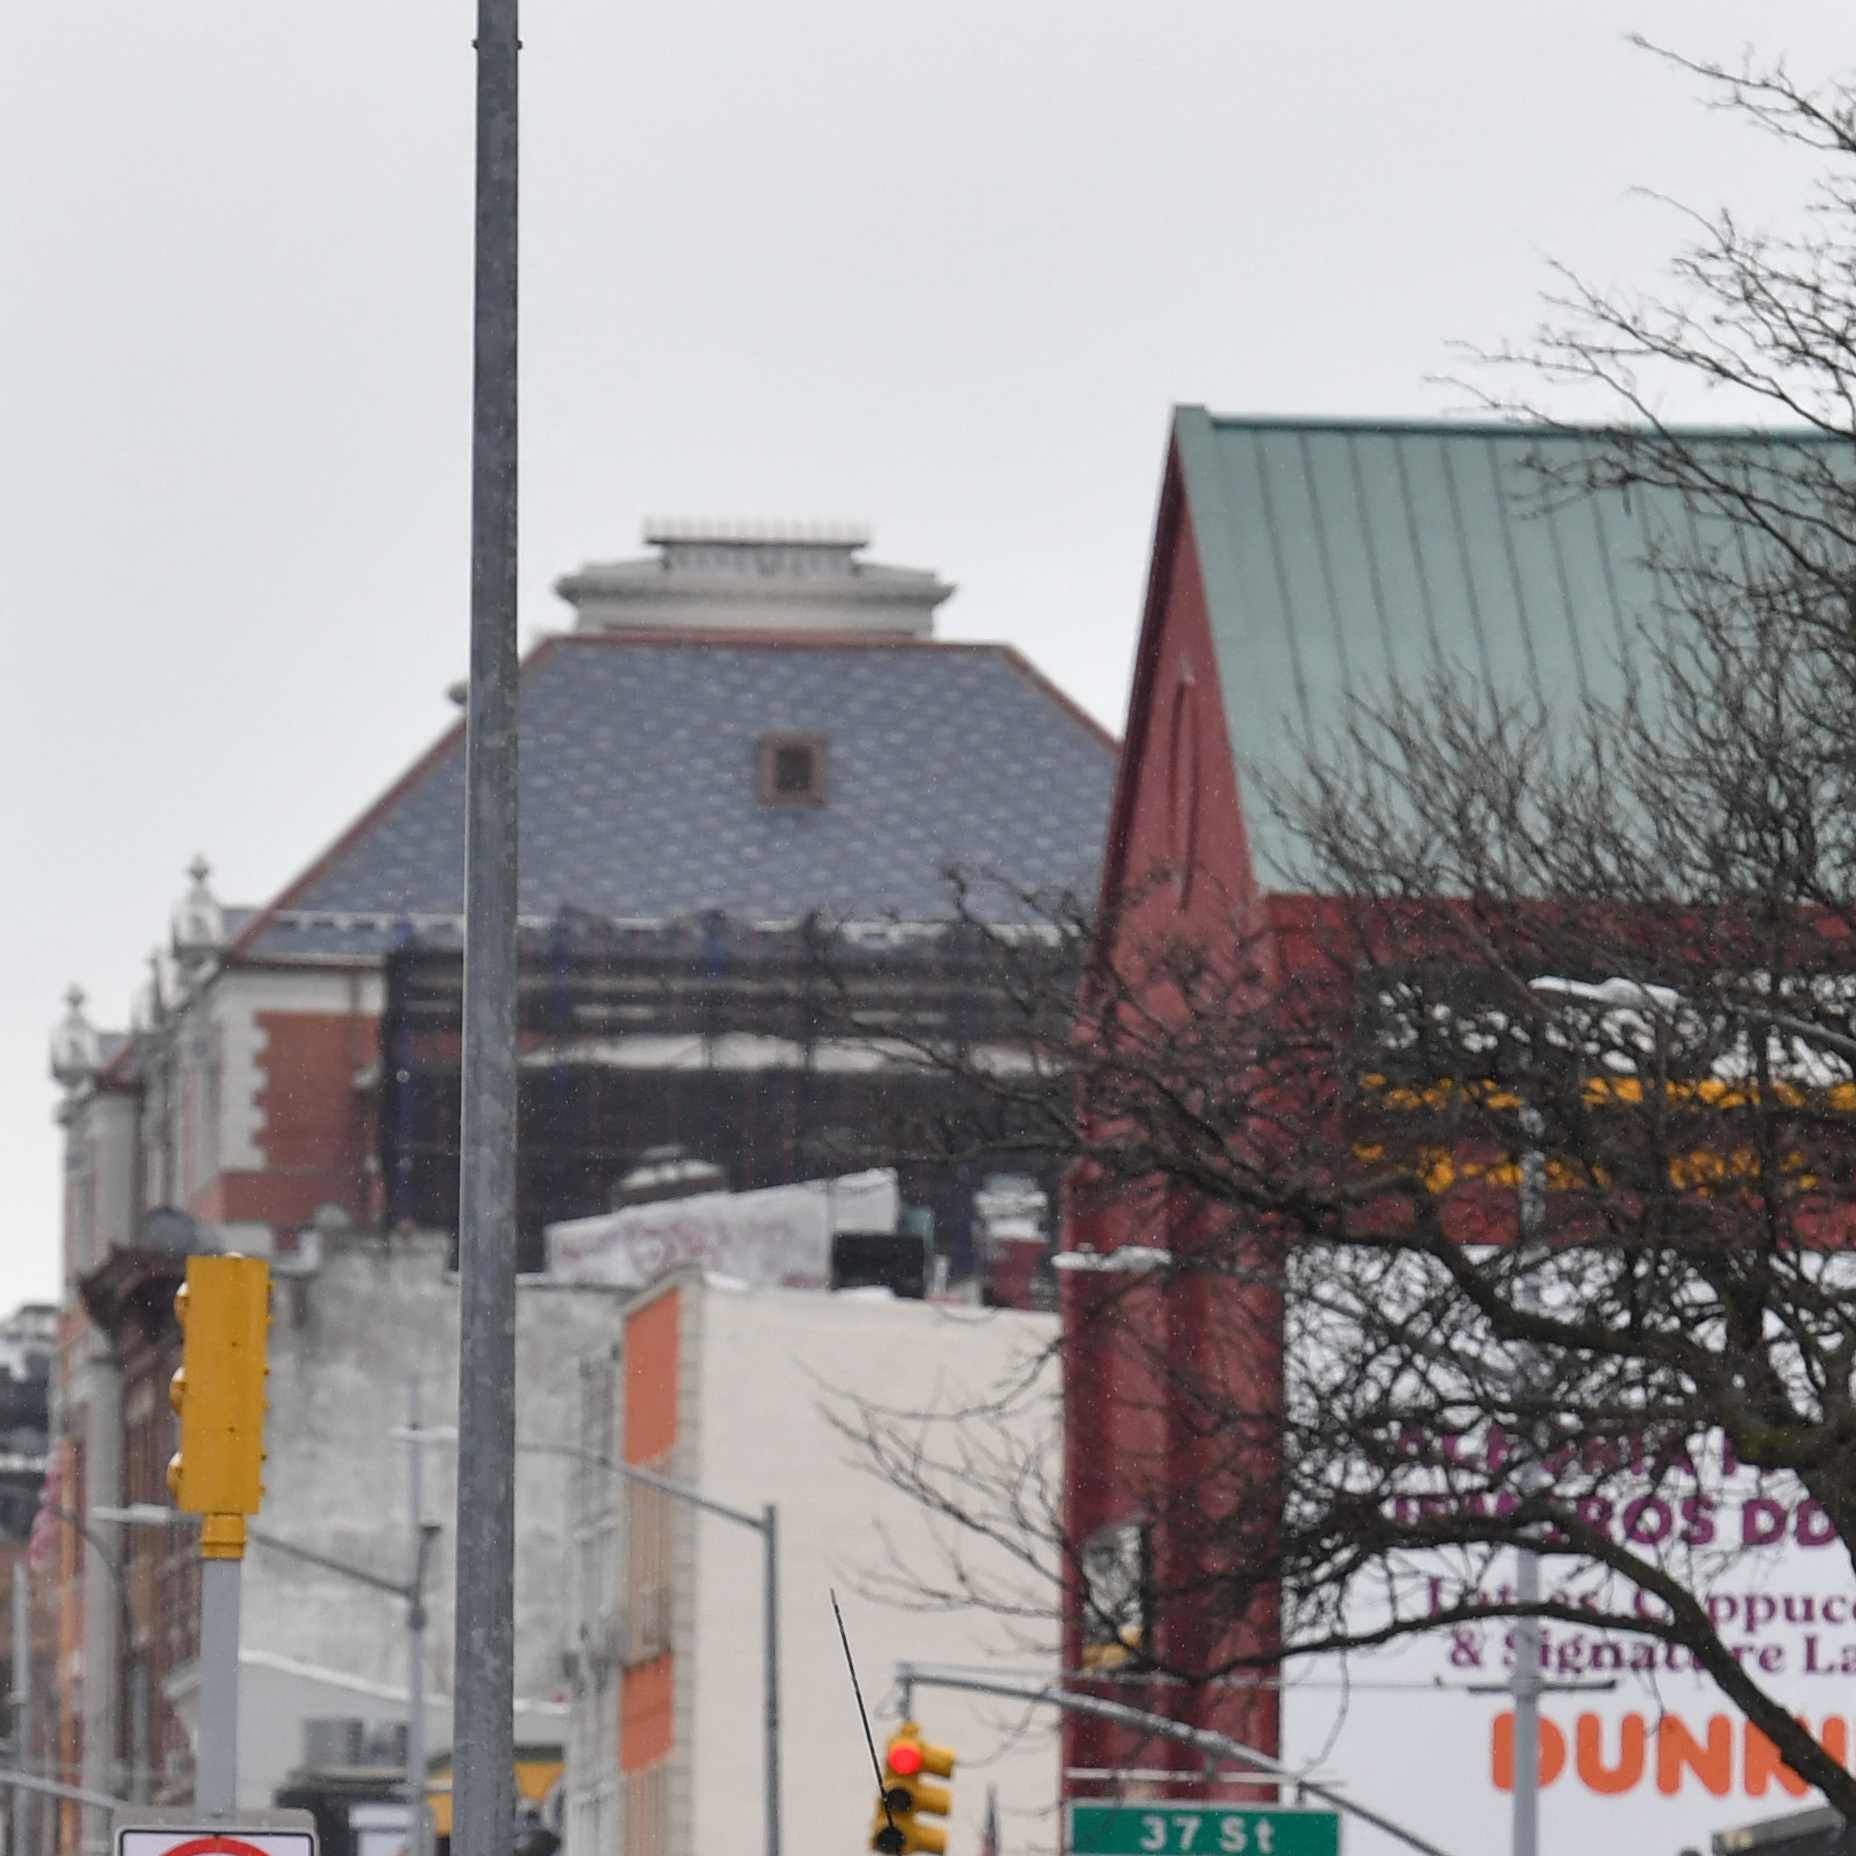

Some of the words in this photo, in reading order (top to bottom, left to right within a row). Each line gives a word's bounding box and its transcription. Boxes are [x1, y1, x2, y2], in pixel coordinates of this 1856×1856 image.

[1448, 1629, 1481, 1668] &
[1140, 1815, 1202, 1852] 37
[1219, 1816, 1275, 1854] St
